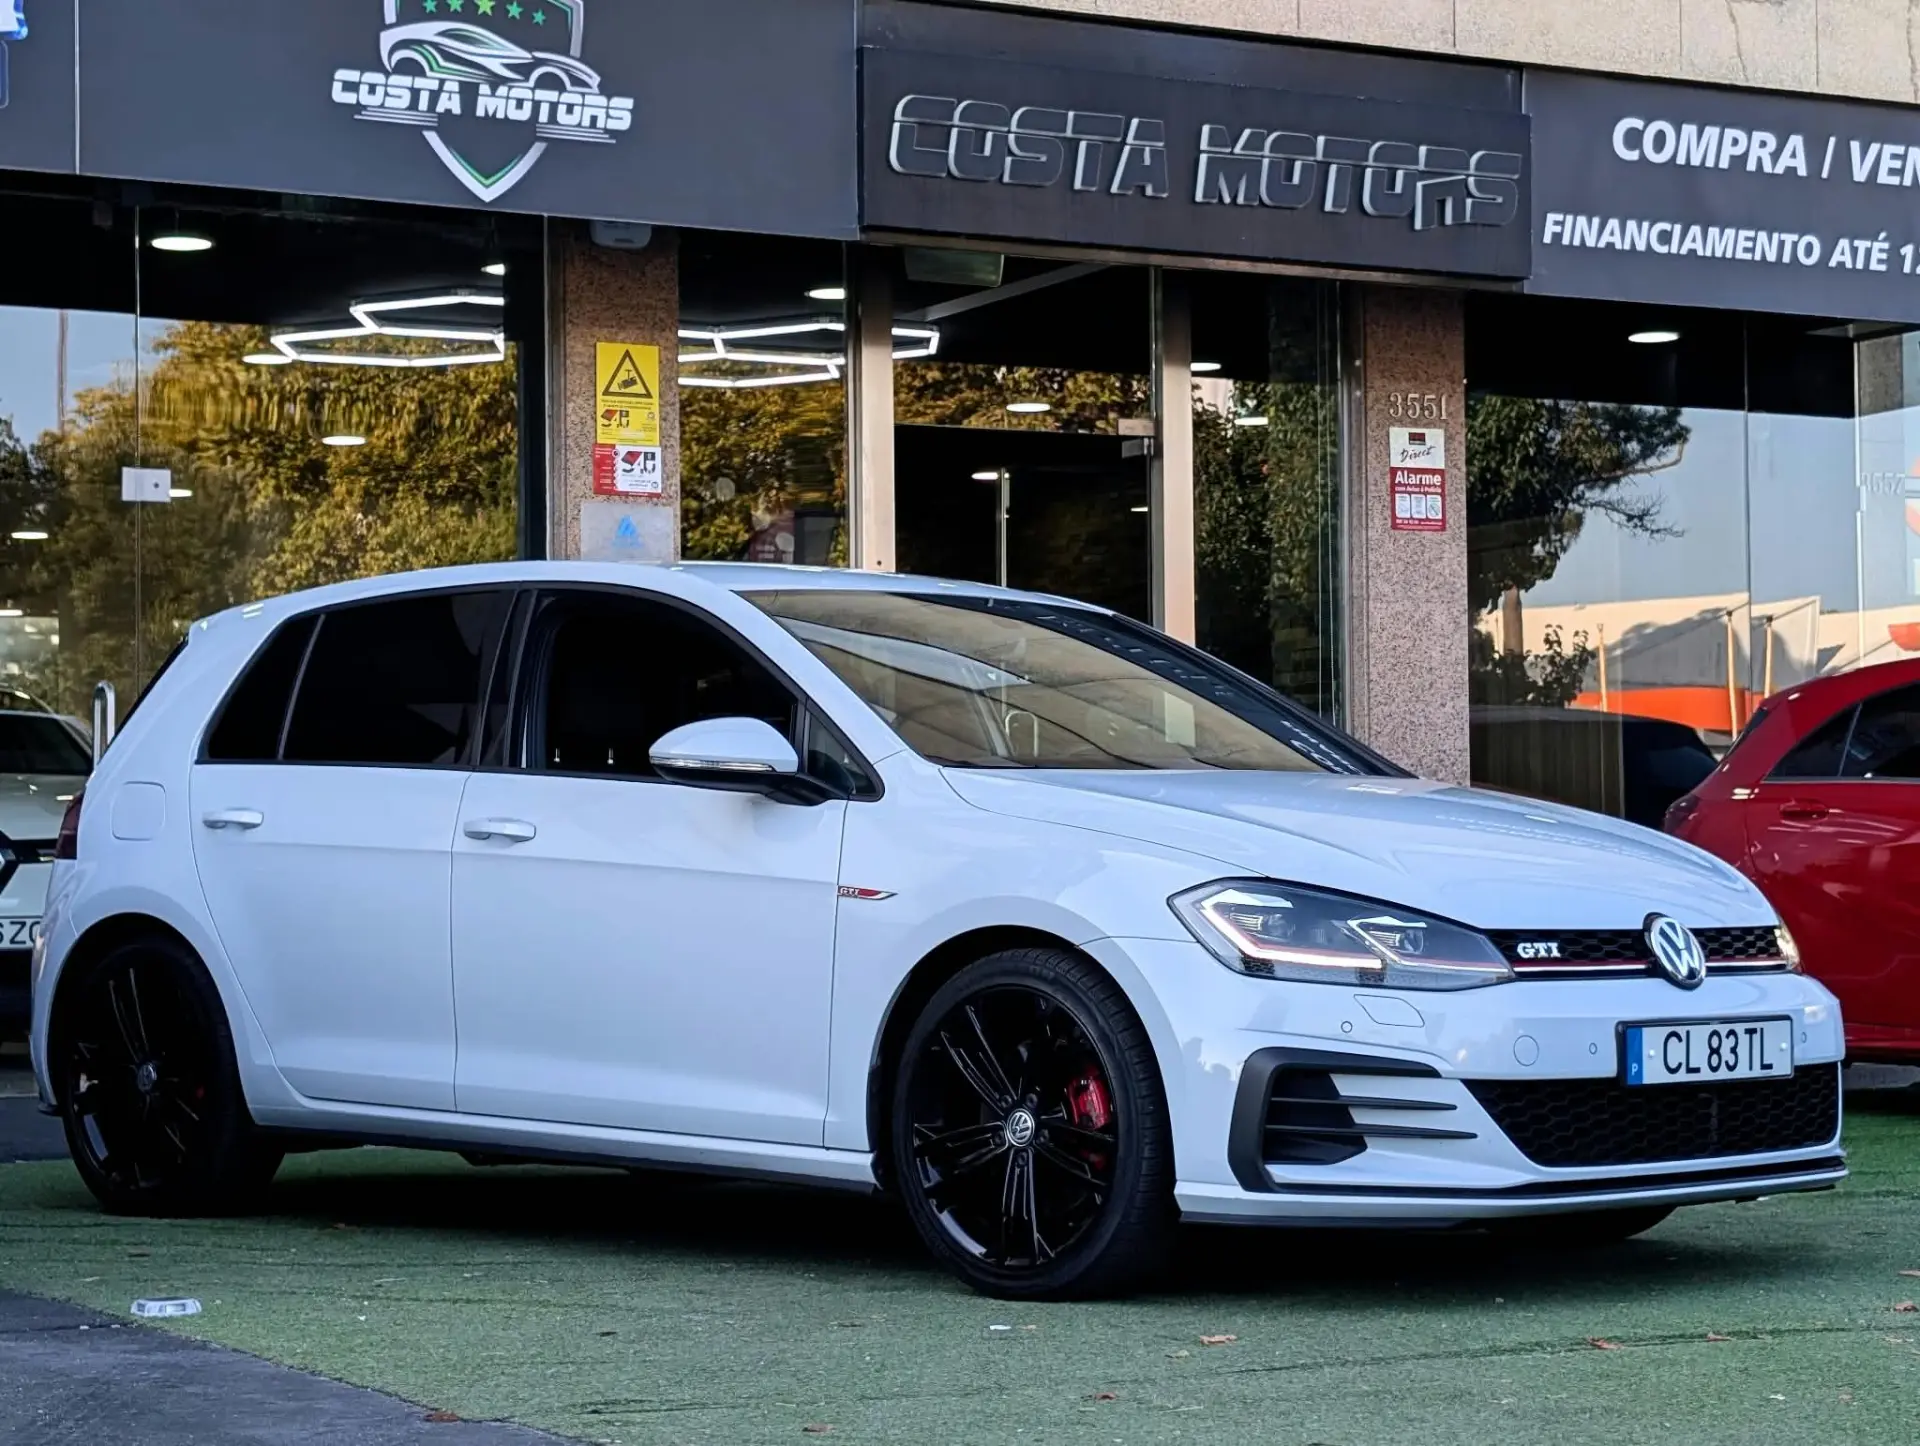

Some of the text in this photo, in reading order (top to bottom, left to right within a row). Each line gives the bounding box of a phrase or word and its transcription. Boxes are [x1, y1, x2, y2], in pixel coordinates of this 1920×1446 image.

[331, 68, 634, 131] COSTA MOTORS
[1612, 117, 1807, 177] COMPRA
[1820, 136, 1836, 179] /
[888, 94, 1523, 231] COSTA MOTORS
[1542, 212, 1920, 275] FINANCIAMENTO ATÉ 1
[1389, 392, 1449, 420] 3551
[1395, 469, 1442, 485] Alarme
[840, 886, 860, 897] GTI
[1516, 941, 1562, 958] GTI
[1631, 1063, 1639, 1076] P
